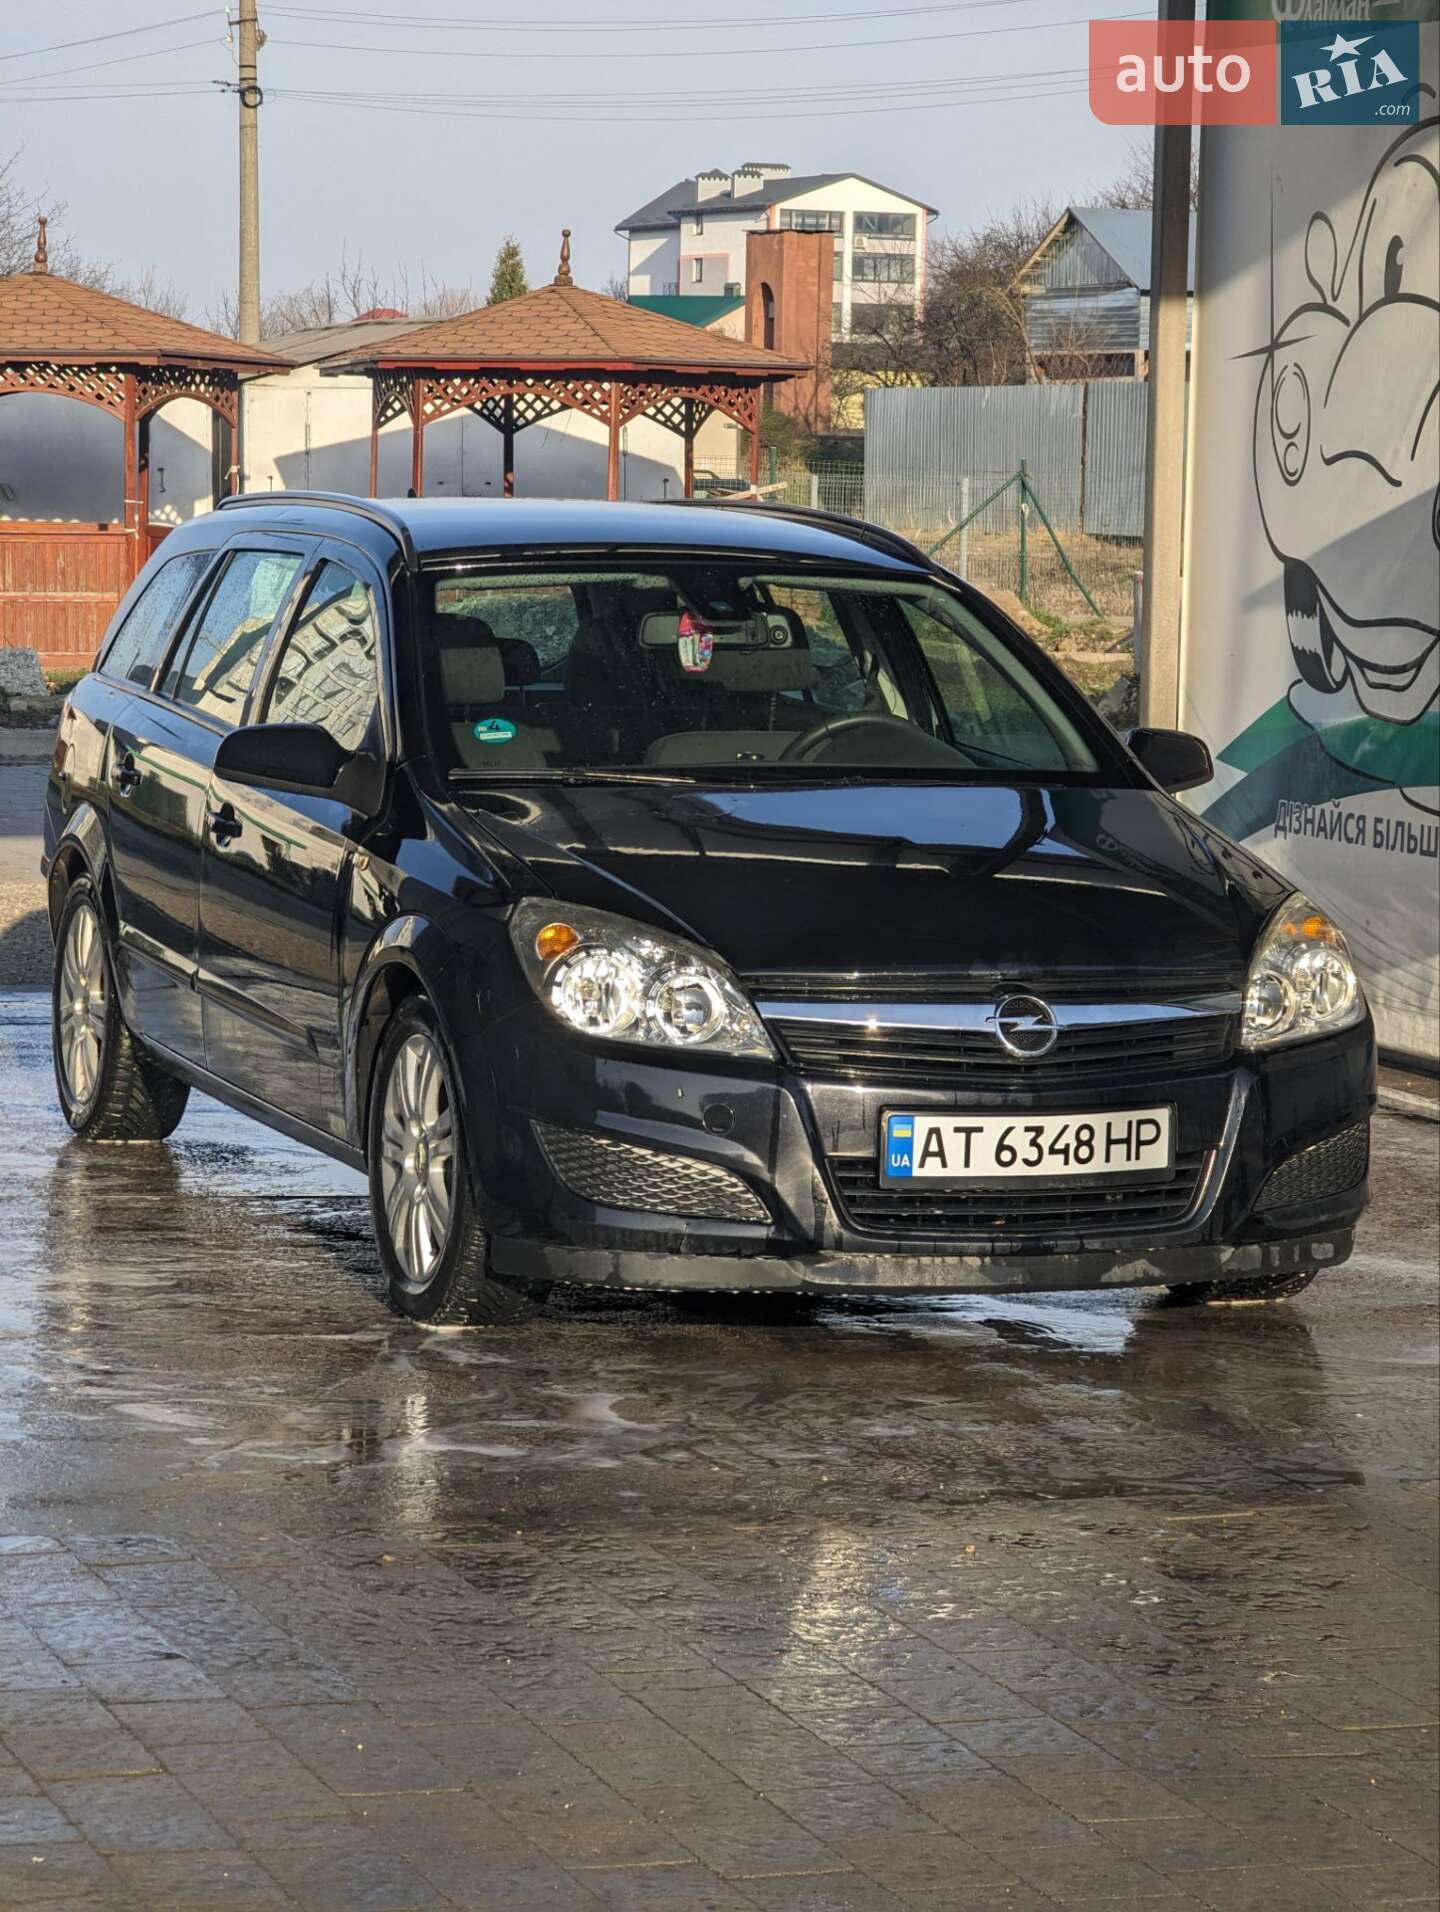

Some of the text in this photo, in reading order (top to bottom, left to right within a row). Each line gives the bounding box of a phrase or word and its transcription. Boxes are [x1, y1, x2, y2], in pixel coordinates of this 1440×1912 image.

[1274, 799, 1366, 846] ДІЗНАЙСЯ
[891, 1153, 910, 1167] UA
[918, 1126, 984, 1169] AT
[994, 1123, 1096, 1168] 6348
